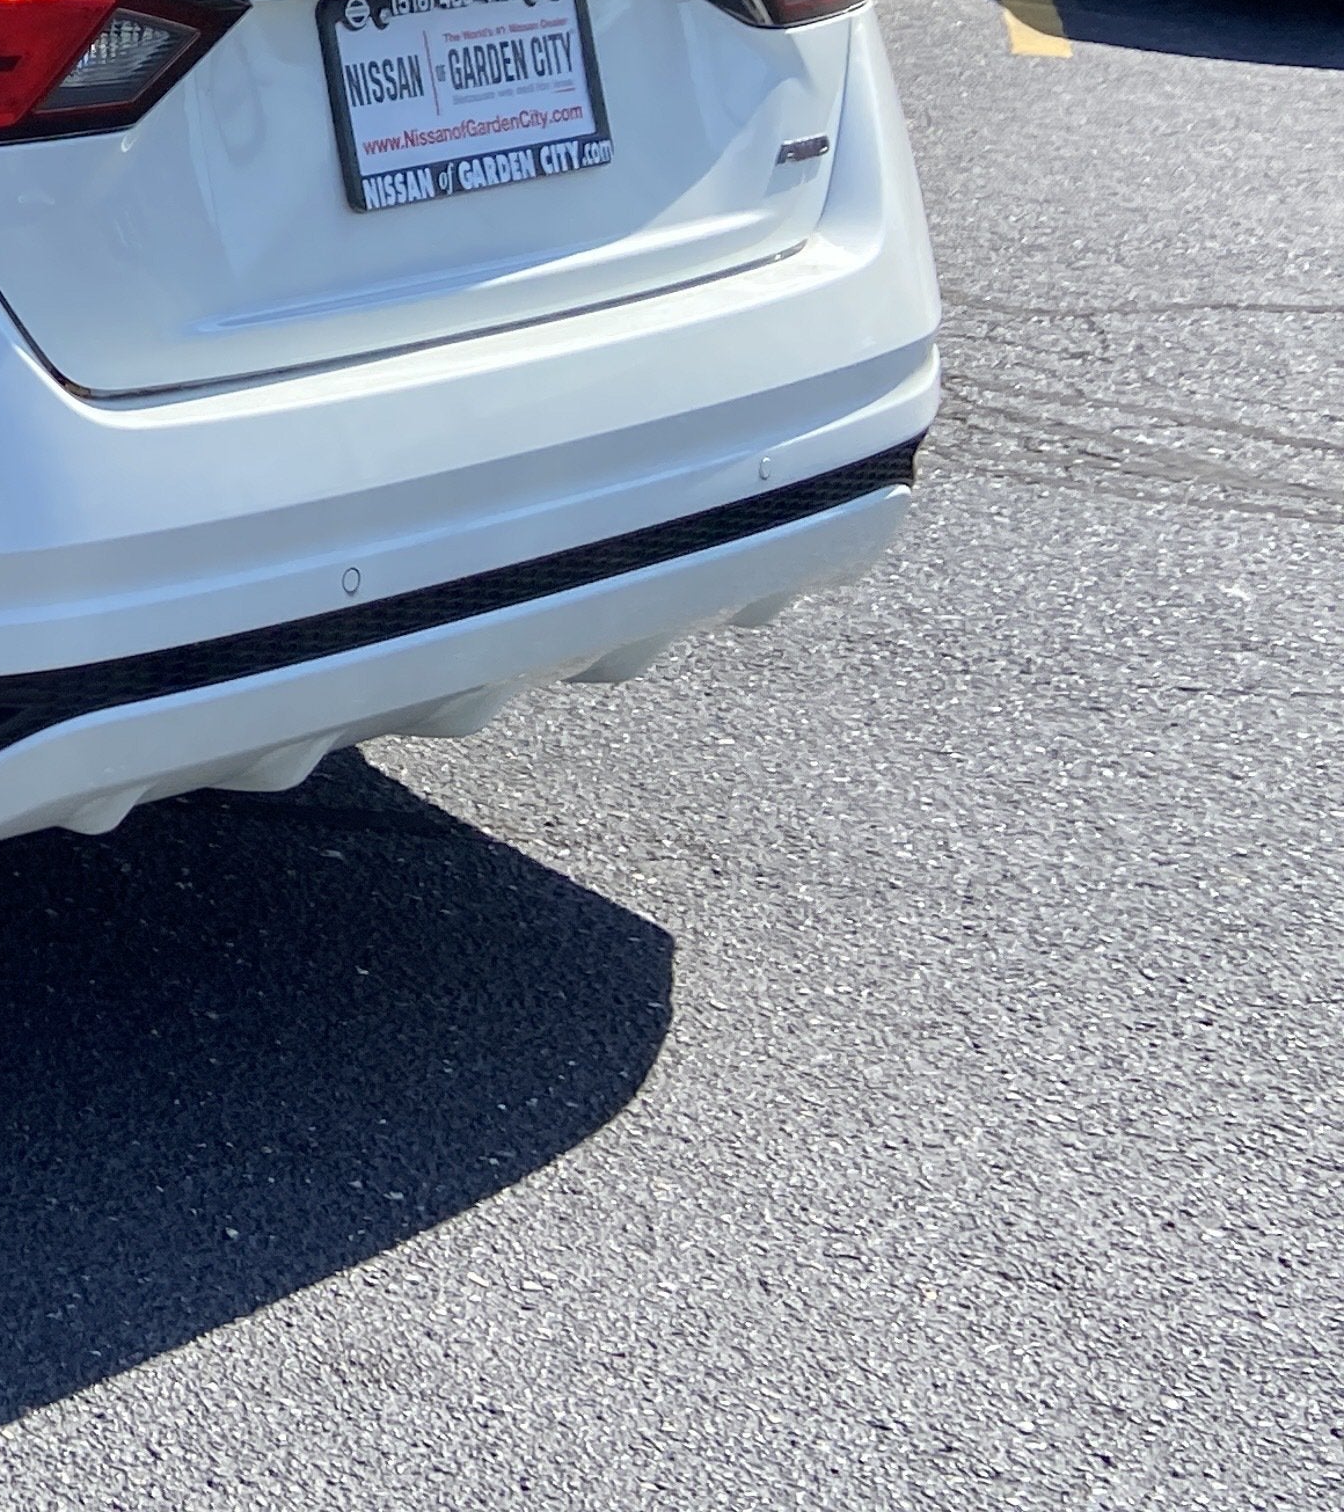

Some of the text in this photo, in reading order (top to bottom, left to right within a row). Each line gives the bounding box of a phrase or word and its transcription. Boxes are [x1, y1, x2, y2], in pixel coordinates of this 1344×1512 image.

[345, 54, 424, 107] NISSAN
[448, 38, 529, 90] GARDEN
[530, 31, 572, 77] CITY
[363, 104, 583, 155] www.NissanofGardenCity.com
[362, 168, 435, 210] NISSAN
[438, 162, 455, 196] of
[458, 148, 537, 190] GARDEN
